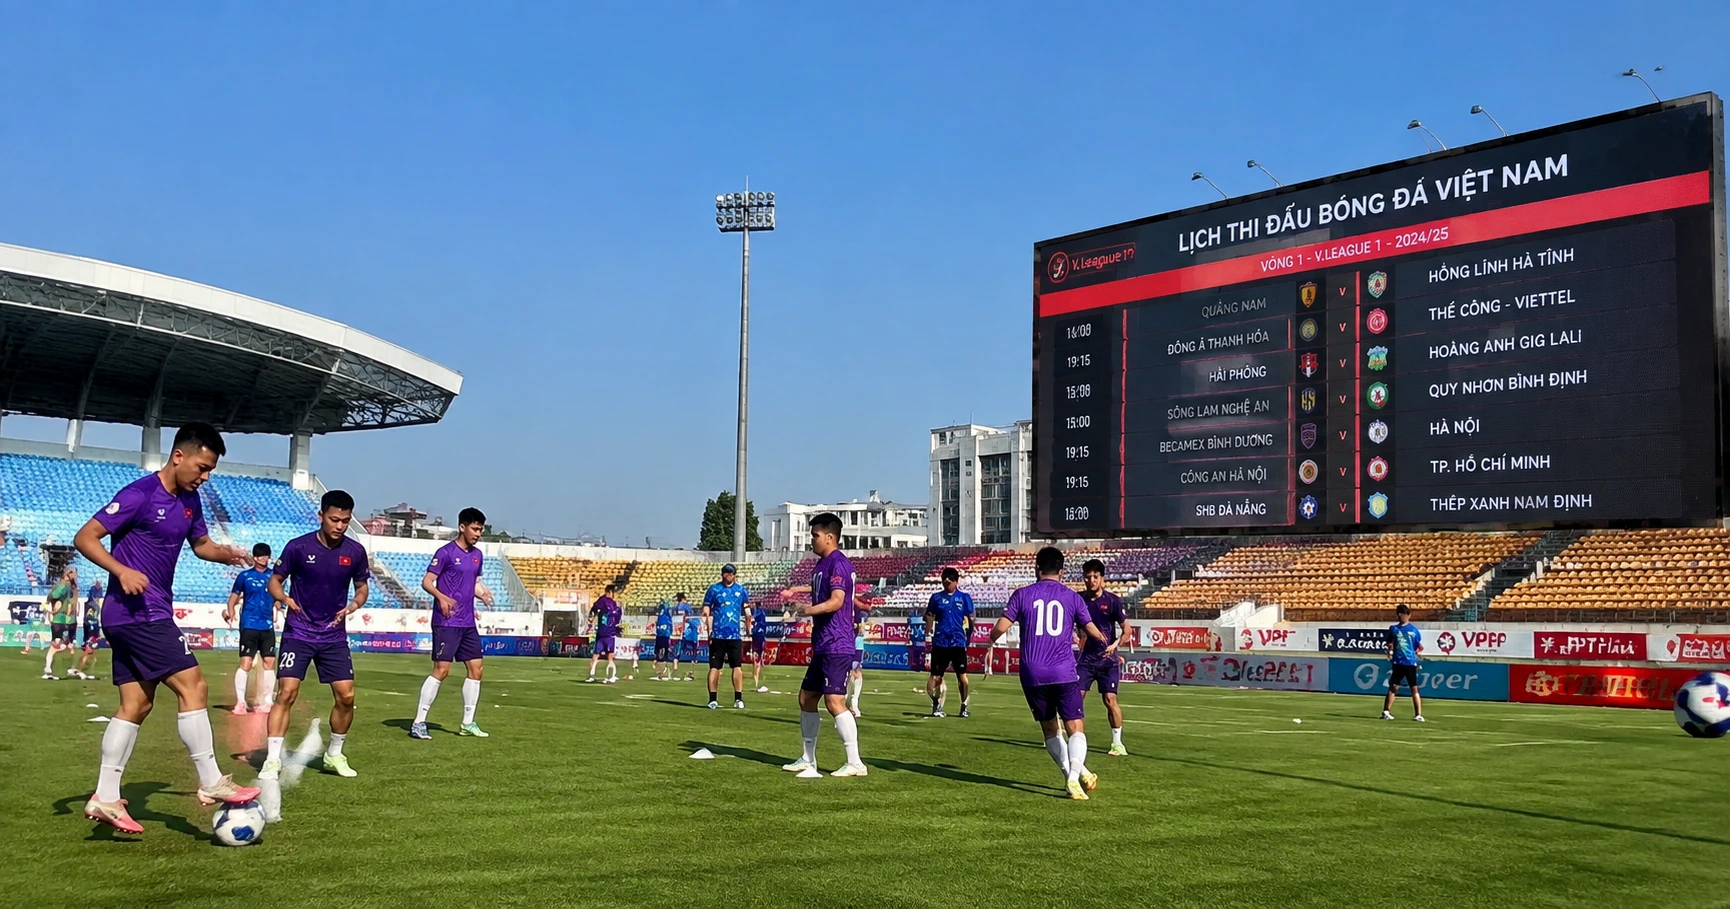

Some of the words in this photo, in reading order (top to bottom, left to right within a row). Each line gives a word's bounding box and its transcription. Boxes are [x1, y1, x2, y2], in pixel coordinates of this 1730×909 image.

[1179, 226, 1221, 254] LỊCH
[1227, 218, 1259, 241] THI
[1319, 194, 1384, 224] BÓNG
[1435, 168, 1494, 201] VIỆT
[1502, 154, 1568, 188] NAM
[1297, 254, 1303, 266] 1
[1314, 241, 1371, 262] V.LEAGUE
[1375, 239, 1381, 252] 1
[1395, 226, 1449, 249] 2024/25
[1512, 252, 1533, 270] HÀ
[1241, 298, 1266, 312] NAM
[1428, 301, 1456, 321] THẾ
[1460, 299, 1500, 317] CÔNG
[1515, 289, 1575, 309] VIETTEL
[1207, 334, 1244, 350] THANH
[1246, 328, 1270, 344] HÓA
[1484, 337, 1515, 353] ANH
[1519, 333, 1545, 349] GIG
[1067, 354, 1091, 368] 19:15
[1429, 382, 1458, 398] QUY
[1549, 369, 1587, 389] ĐỊNH
[1197, 404, 1219, 417] LAM
[1221, 398, 1250, 417] NGHỆ
[1253, 400, 1270, 413] AN
[1430, 418, 1450, 435] HÀ
[1454, 416, 1480, 436] NỘI
[1066, 445, 1089, 459] 19:15
[1159, 439, 1205, 453] BECAMEX
[1430, 460, 1451, 474] TP.
[1481, 452, 1507, 471] CHÍ
[1511, 455, 1551, 470] MINH
[1065, 476, 1089, 489] 19:15
[1211, 470, 1226, 483] AN
[1247, 465, 1267, 484] NỘI
[1195, 504, 1216, 517] SHB
[1469, 496, 1510, 511] XANH
[1514, 495, 1549, 510] NAM
[1553, 494, 1592, 512] ĐỊNH
[1033, 599, 1064, 637] 10
[279, 651, 296, 669] 28
